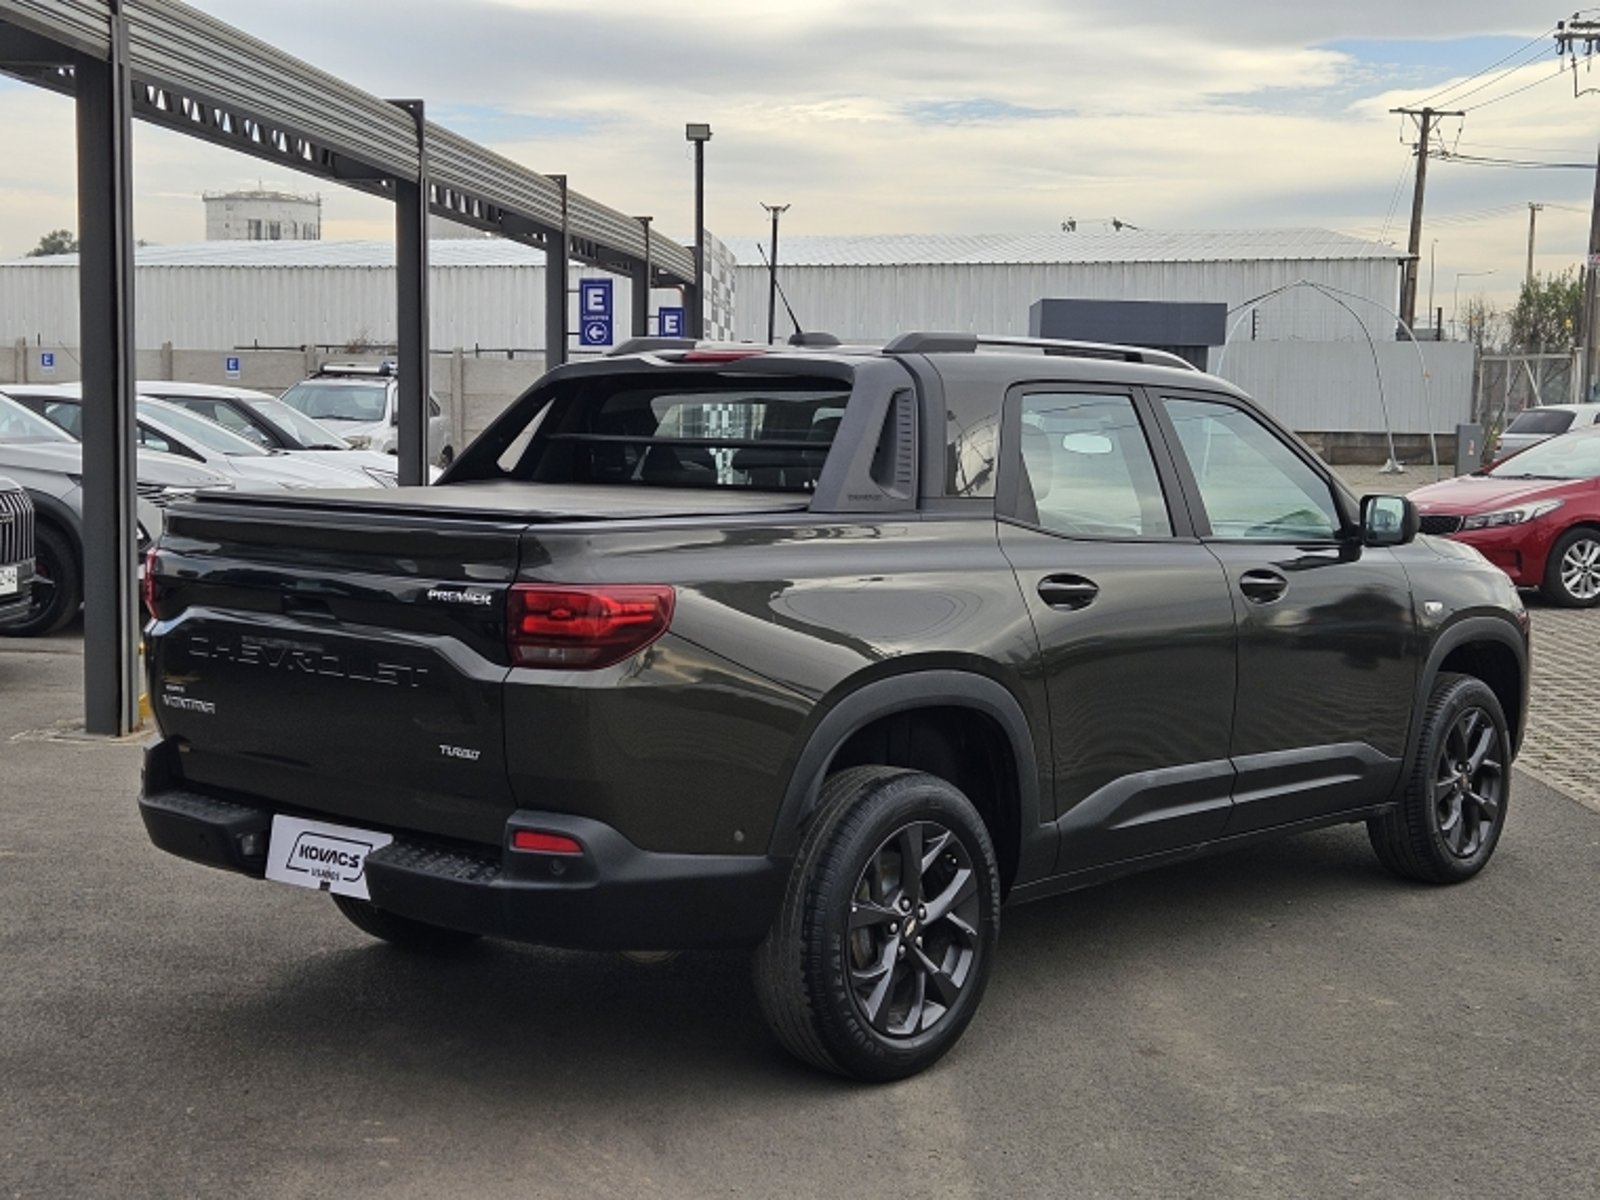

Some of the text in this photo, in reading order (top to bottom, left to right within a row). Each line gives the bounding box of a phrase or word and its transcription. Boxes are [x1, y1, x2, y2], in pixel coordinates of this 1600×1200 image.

[587, 288, 605, 311] E
[664, 315, 679, 334] E
[427, 589, 492, 606] PREMIER
[188, 636, 429, 688] CHEVROLET
[299, 844, 360, 868] KOVACS
